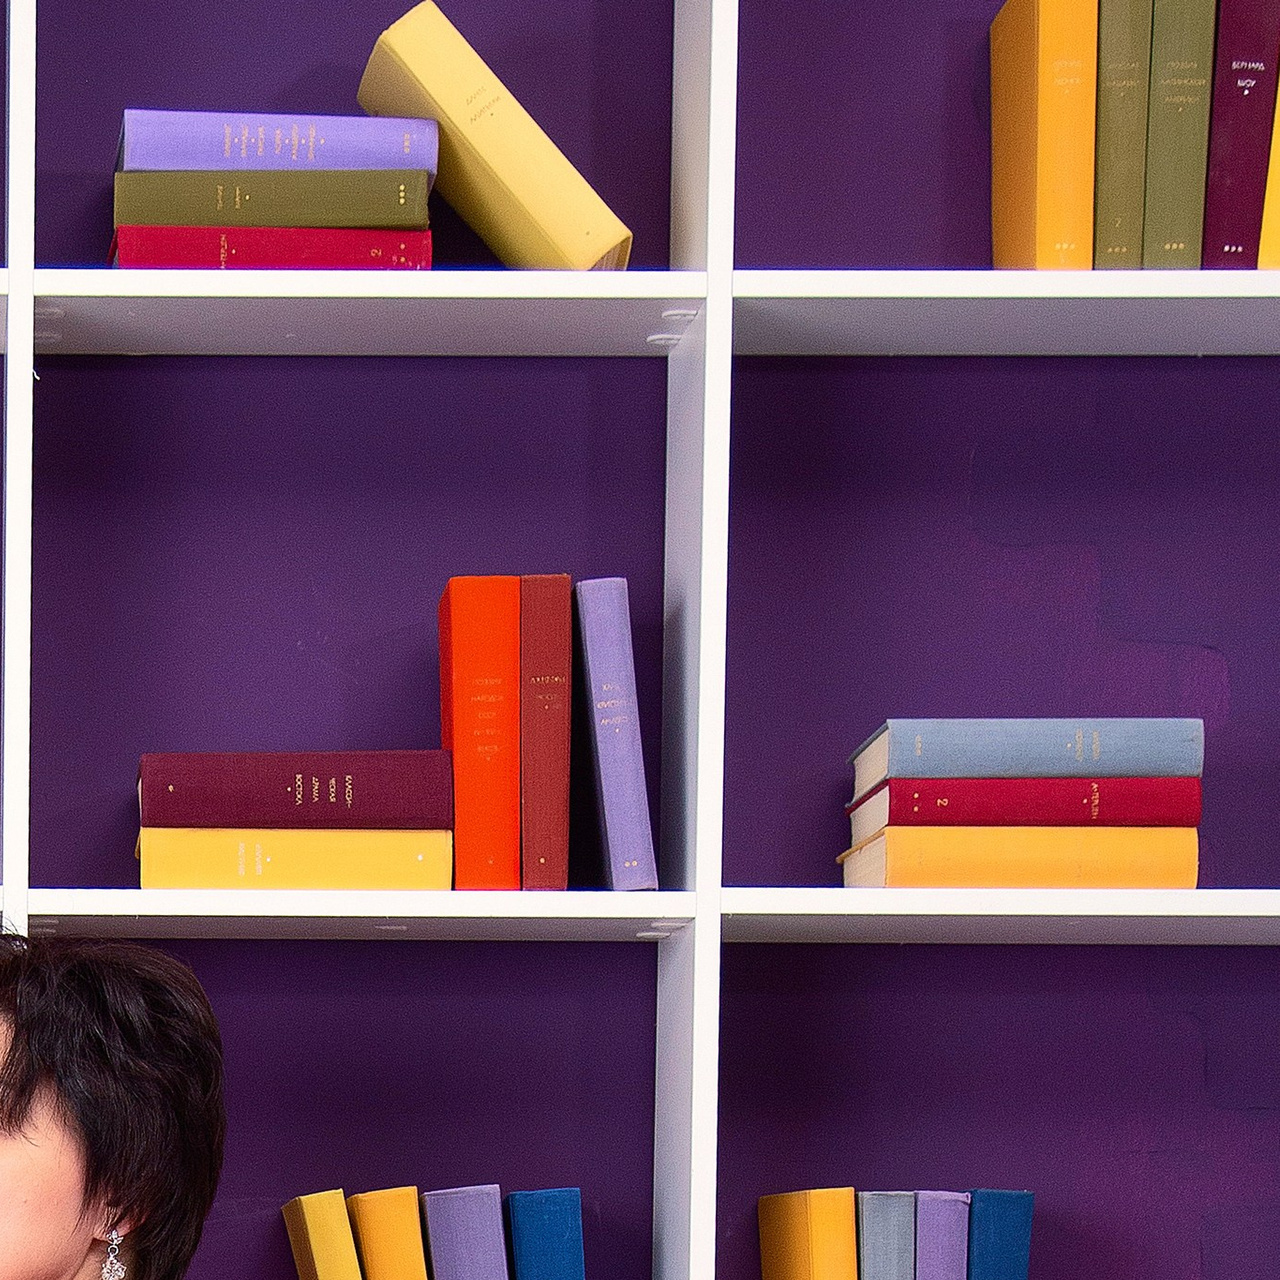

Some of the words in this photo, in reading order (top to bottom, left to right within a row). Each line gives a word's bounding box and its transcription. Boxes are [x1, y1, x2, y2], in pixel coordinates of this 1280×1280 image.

[1231, 60, 1265, 72] БЕРНАРД
[1236, 78, 1256, 89] ШОУ
[295, 773, 303, 807] ВОСТОКА
[311, 776, 320, 803] ДРАМА
[328, 776, 337, 802] ЧЕСКАЯ
[345, 774, 353, 809] КЛАССИ-
[936, 797, 948, 807] 2
